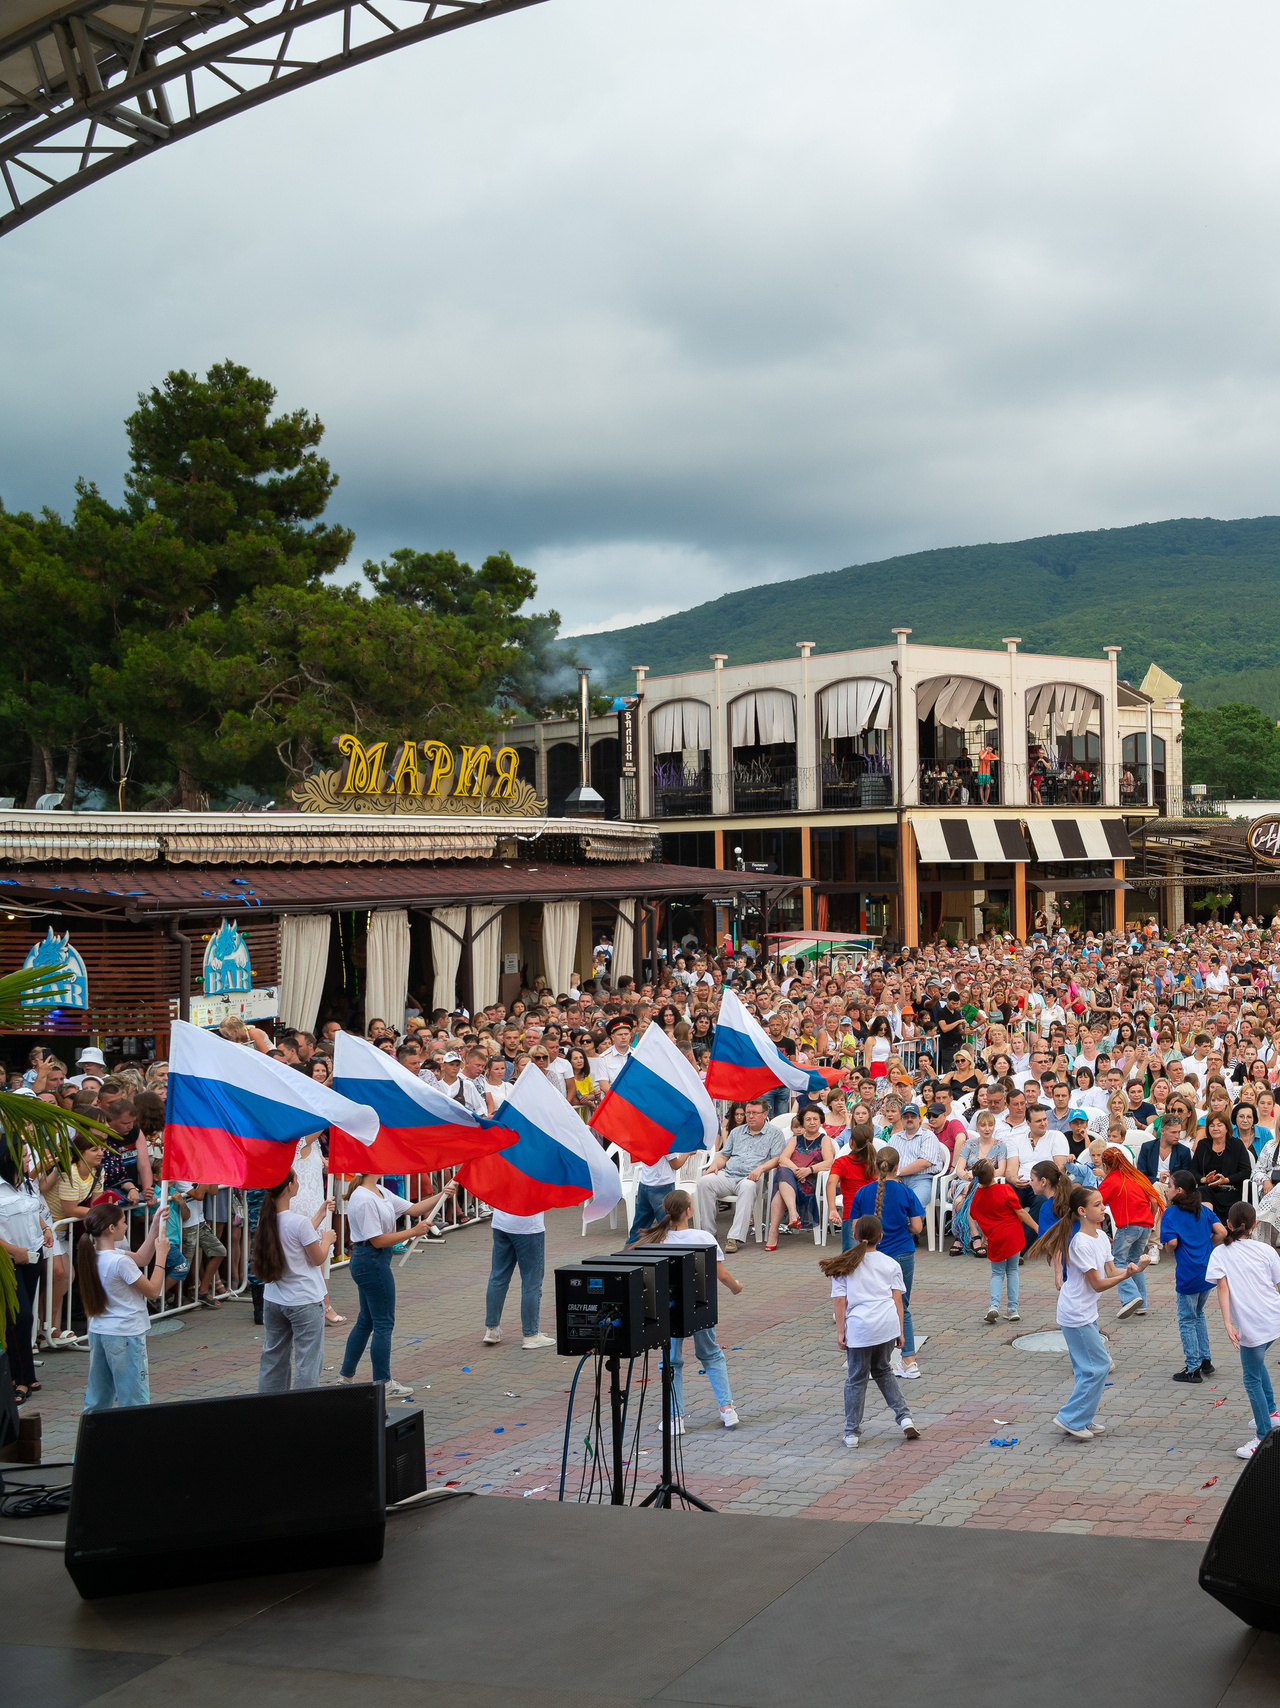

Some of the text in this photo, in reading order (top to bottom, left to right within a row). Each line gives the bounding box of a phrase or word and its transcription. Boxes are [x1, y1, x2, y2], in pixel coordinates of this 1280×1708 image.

[338, 734, 520, 799] МАРИЯ
[208, 969, 249, 993] BAR
[568, 1303, 583, 1311] CRAZY
